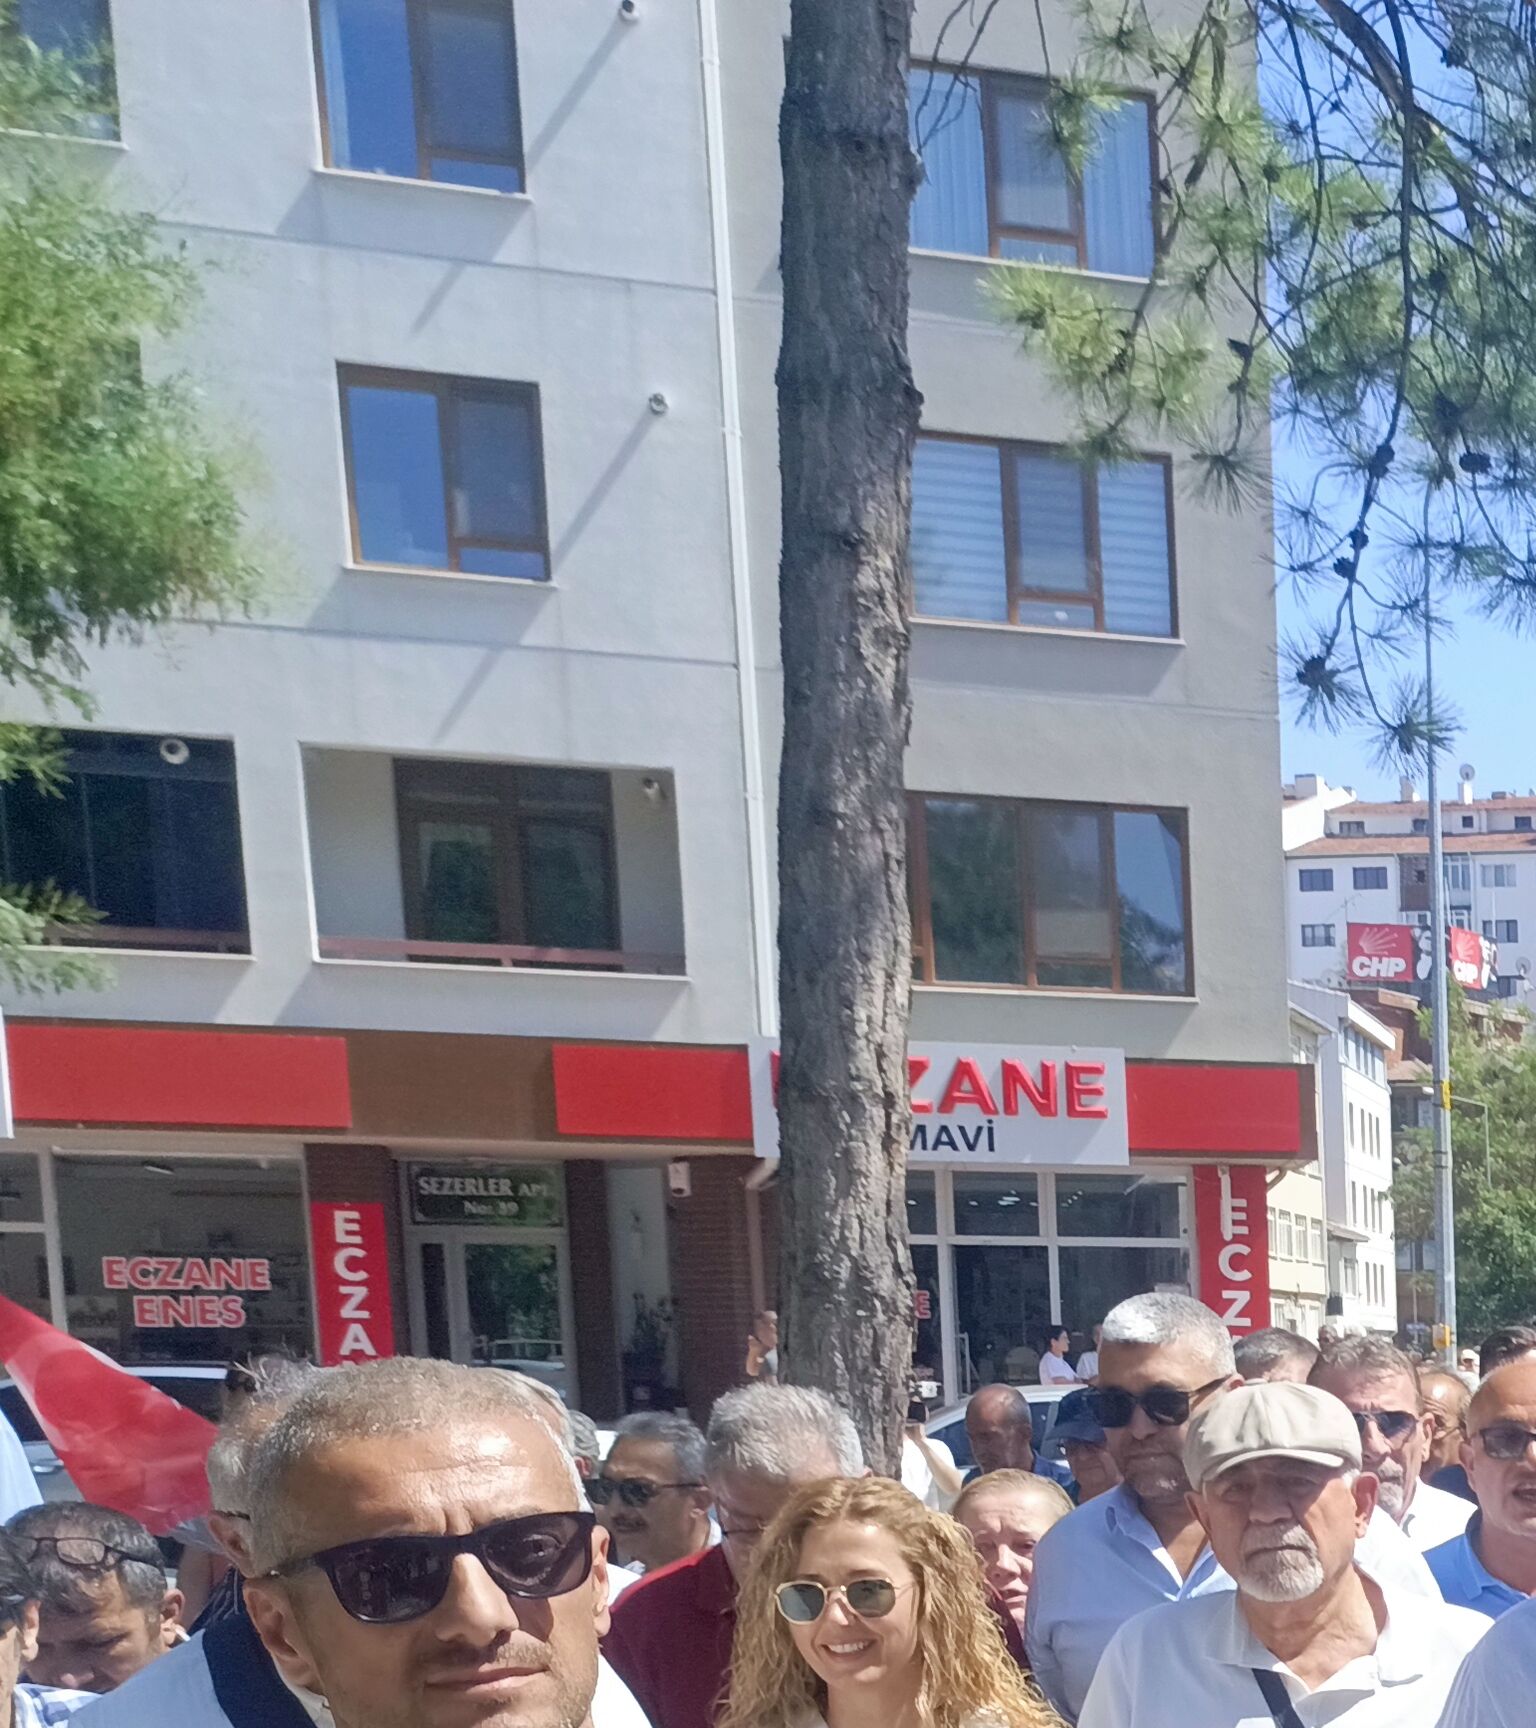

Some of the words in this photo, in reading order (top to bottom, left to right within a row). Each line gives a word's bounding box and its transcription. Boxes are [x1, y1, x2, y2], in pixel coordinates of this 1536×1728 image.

[1352, 956, 1407, 978] CHP
[770, 1050, 1109, 1119] ZANE
[418, 1176, 515, 1196] SEZERLER
[102, 1256, 272, 1291] ECZANE
[333, 1210, 378, 1364] ECZA
[133, 1295, 246, 1328] ENES
